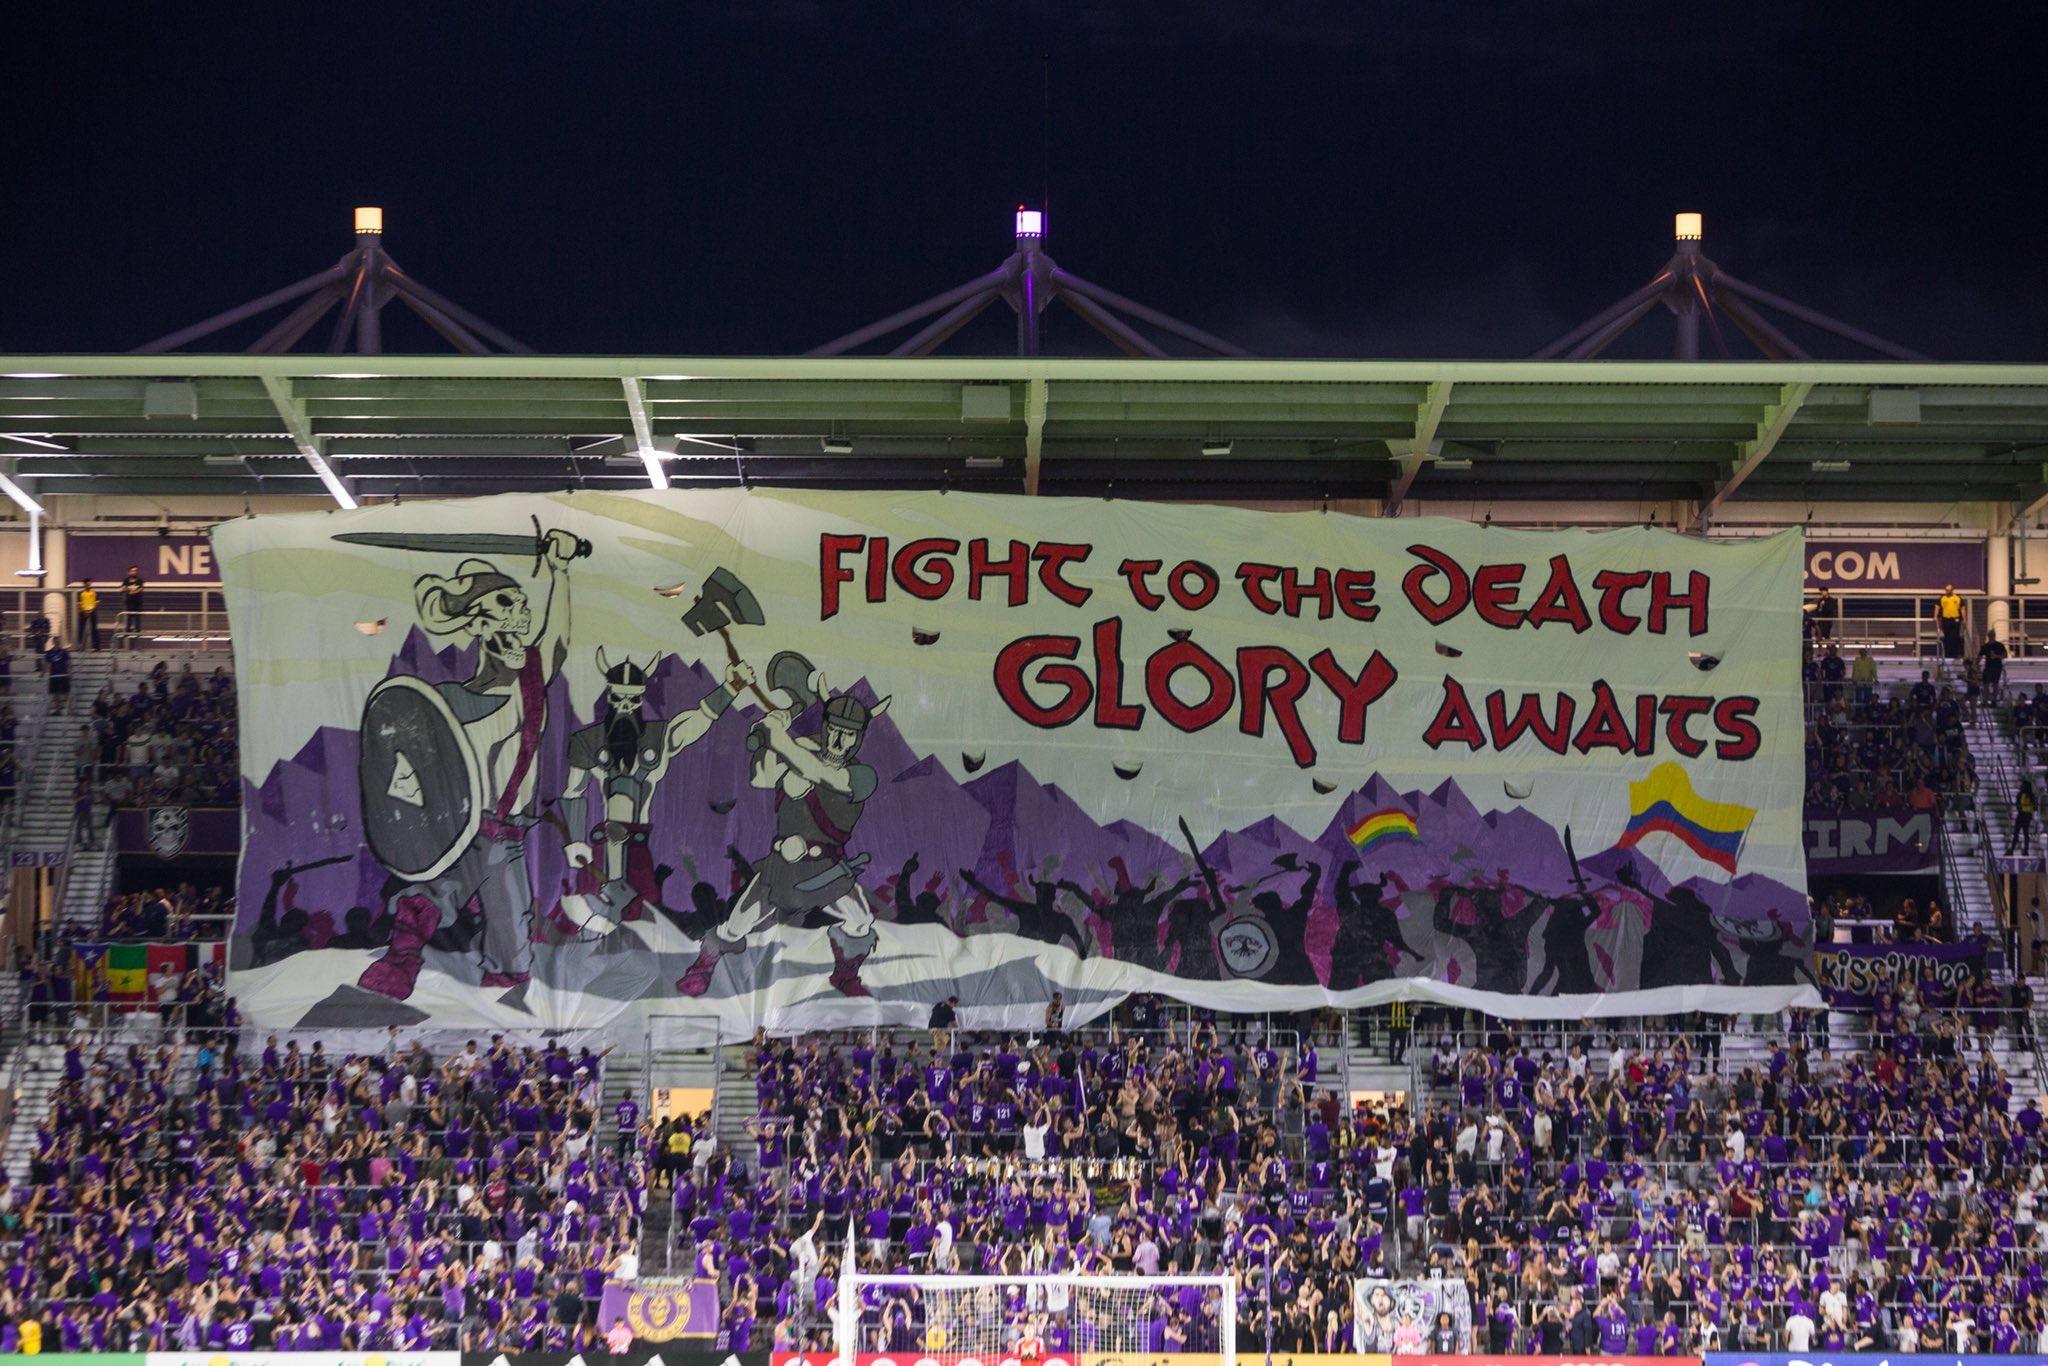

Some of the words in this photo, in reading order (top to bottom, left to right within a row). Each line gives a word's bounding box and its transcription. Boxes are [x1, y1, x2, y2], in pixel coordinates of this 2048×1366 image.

[820, 532, 1094, 621] FIGHT
[1118, 559, 1221, 612] TO
[1235, 562, 1381, 622] THE
[1401, 544, 1711, 637] DEATH
[993, 616, 1398, 769] GLORY
[1422, 674, 1761, 761] AWAITS
[1802, 813, 1931, 859] IRM
